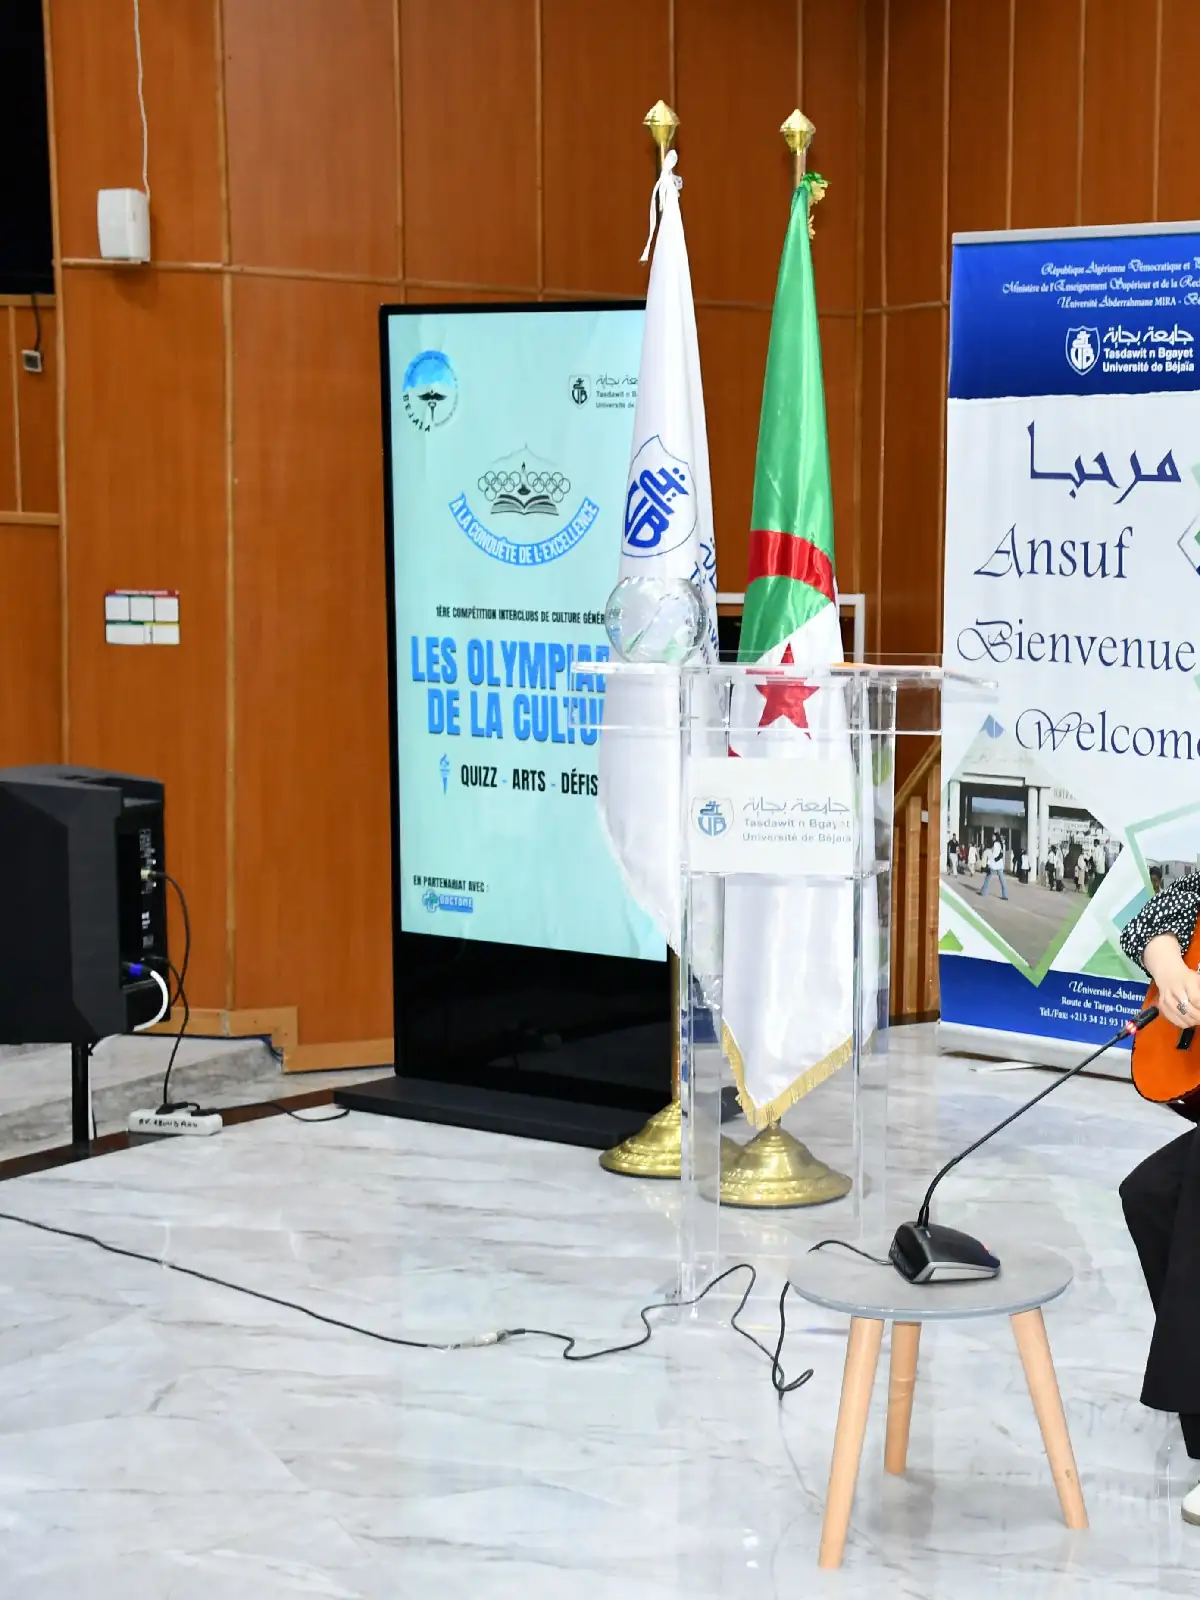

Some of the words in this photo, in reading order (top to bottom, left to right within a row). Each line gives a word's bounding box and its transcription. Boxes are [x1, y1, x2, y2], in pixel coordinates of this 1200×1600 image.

[1041, 262, 1084, 277] République
[1085, 260, 1125, 275] Algérienne
[1128, 259, 1182, 273] Démocratique
[1183, 262, 1190, 270] et
[1002, 281, 1039, 294] Ministère
[1041, 282, 1049, 292] de
[1110, 277, 1151, 292] Supérieur
[1153, 280, 1159, 289] et
[1160, 278, 1169, 288] de
[1171, 278, 1177, 288] la
[1057, 296, 1098, 309] Université
[1099, 295, 1153, 307] Abderrahmane
[1155, 296, 1176, 306] MIRA
[1103, 324, 1141, 348] بجاية
[1143, 323, 1194, 346] جامعة
[1103, 348, 1147, 359] Tasdawit
[1149, 350, 1155, 358] n
[1158, 347, 1193, 360] Bgayet
[1103, 361, 1149, 372] Université
[1151, 361, 1162, 372] de
[1165, 360, 1194, 374] Béjaïa
[1027, 420, 1182, 504] مرحبا
[459, 508, 470, 529] LA
[467, 521, 517, 563] CONQUÊTE
[519, 546, 533, 564] DE
[973, 523, 1134, 579] Ansuf
[453, 605, 496, 620] COMPÉTITION
[499, 608, 539, 622] INTERCLUBS
[541, 611, 549, 623] DE
[552, 612, 581, 624] CULTURE
[583, 610, 605, 625] GÉNÉR
[956, 619, 1196, 672] Bienvenue
[411, 636, 457, 684] LES
[467, 638, 610, 693] OLYMPIAD
[428, 688, 461, 736] DE
[470, 691, 503, 739] LA
[513, 693, 605, 745] CULTU
[461, 764, 497, 787] QUIZZ
[512, 769, 546, 792] ARTS
[561, 769, 598, 796] DÉFIS
[742, 796, 788, 818] بجاية
[791, 796, 850, 815] جامعة
[744, 818, 794, 828] Tasdawit
[742, 832, 797, 842] Université
[801, 832, 814, 842] de
[413, 875, 421, 886] EN
[423, 876, 466, 891] PARTENARIAT
[468, 880, 485, 892] AVEC
[1069, 981, 1111, 997] Université
[1061, 996, 1081, 1007] Route
[1083, 999, 1092, 1009] de
[1094, 1000, 1141, 1015] Targa-Ouzem
[1070, 1012, 1087, 1022] +213
[1089, 1014, 1097, 1023] 34
[1100, 1016, 1107, 1025] 21
[1109, 1017, 1118, 1027] 93
